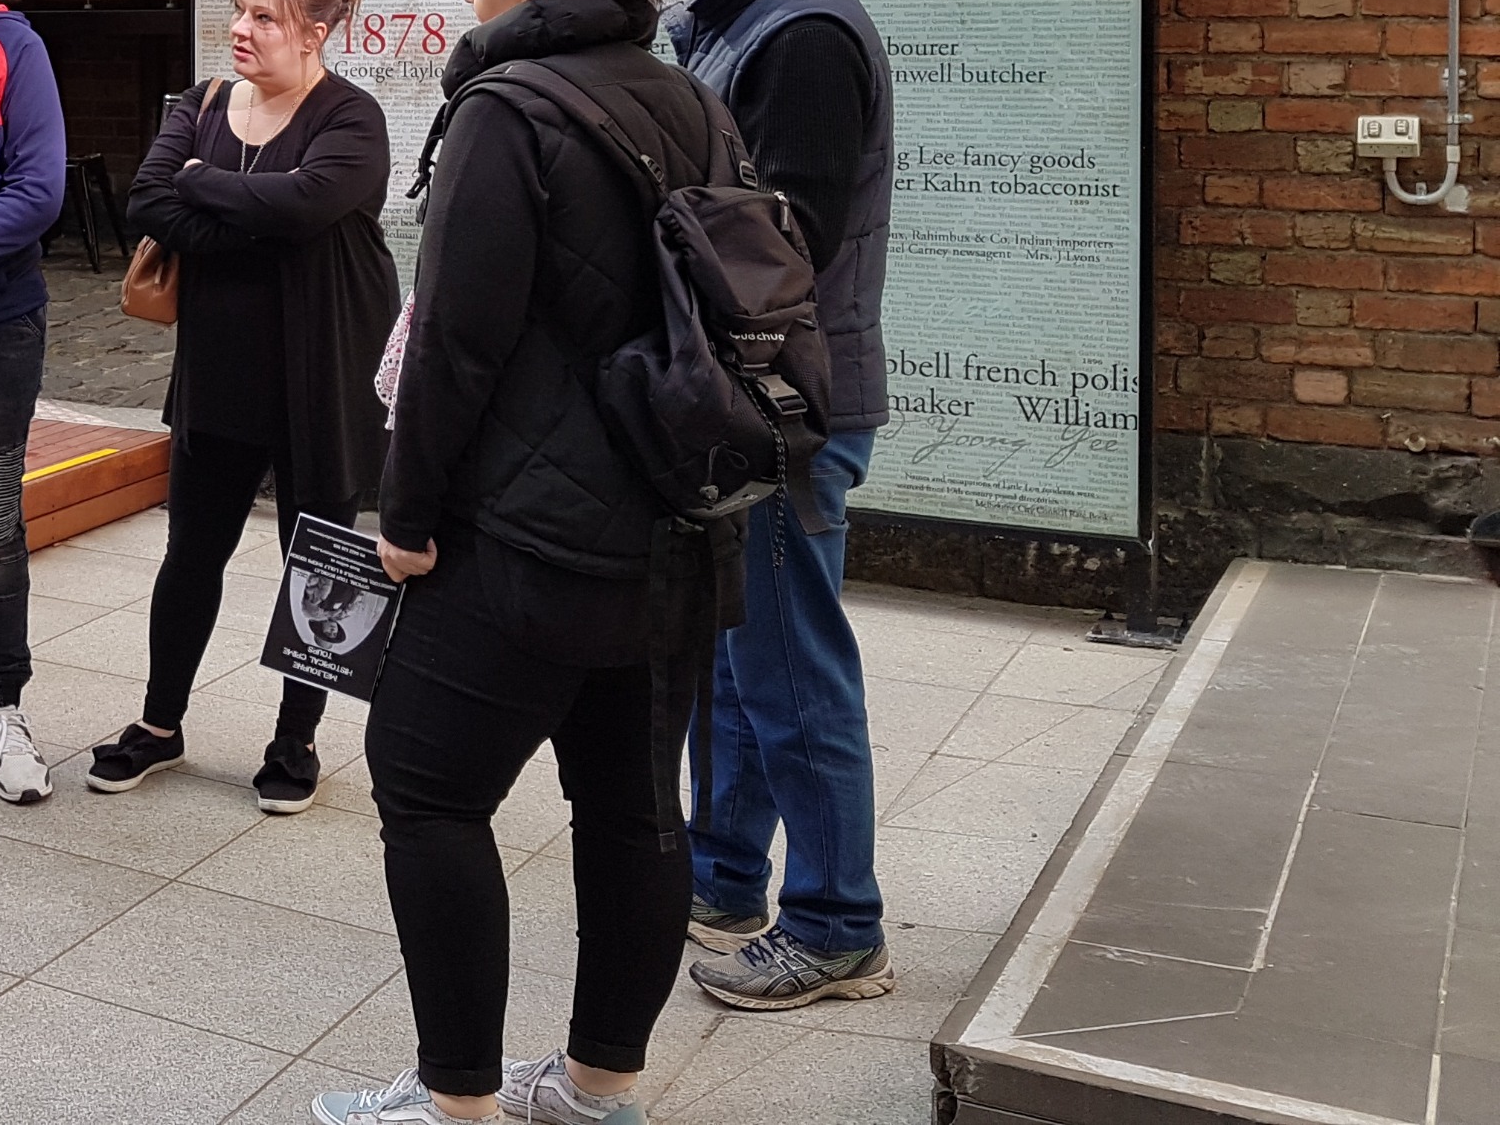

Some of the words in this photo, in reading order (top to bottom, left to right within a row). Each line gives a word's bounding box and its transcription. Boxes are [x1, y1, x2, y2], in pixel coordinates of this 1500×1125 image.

[341, 13, 447, 58] 1878
[334, 60, 394, 83] George
[398, 61, 445, 82] Taylo
[961, 63, 1047, 84] butcher
[917, 145, 955, 166] Lee
[963, 145, 1023, 173] fancy
[1029, 148, 1097, 174] goods
[923, 172, 982, 194] Kahn
[990, 173, 1121, 198] tobacconist
[912, 229, 971, 243] Rahimbux
[974, 233, 986, 243] &
[1015, 234, 1053, 247] Indian
[1056, 236, 1115, 251] importers
[908, 243, 949, 258] Carney
[952, 247, 1011, 261] newsagent
[1066, 252, 1101, 265] Lyons
[963, 354, 1059, 387] french
[1012, 395, 1138, 430] William
